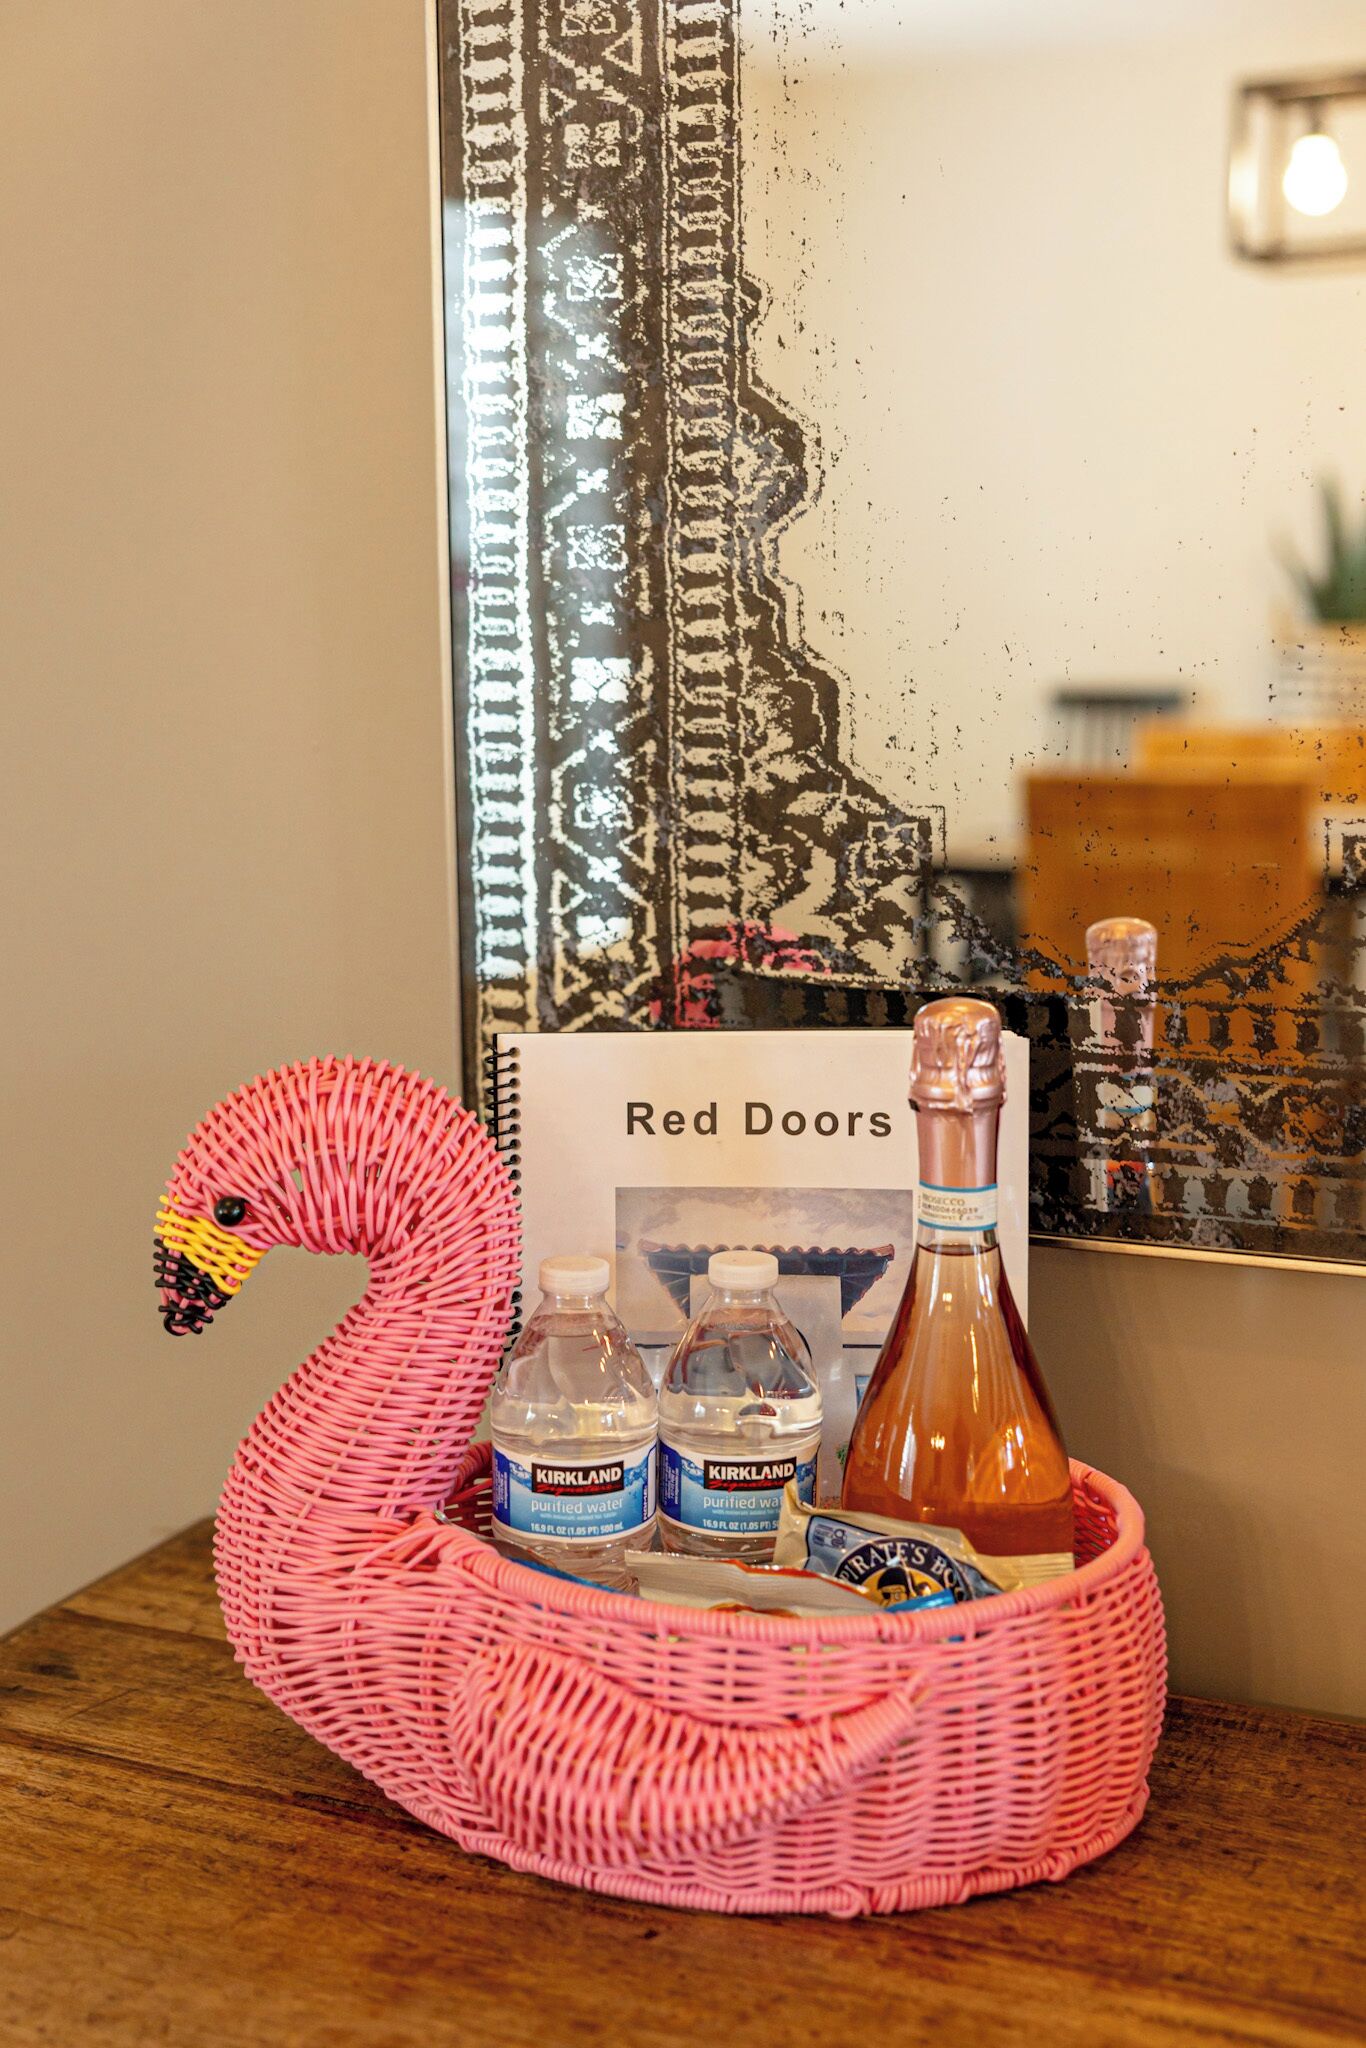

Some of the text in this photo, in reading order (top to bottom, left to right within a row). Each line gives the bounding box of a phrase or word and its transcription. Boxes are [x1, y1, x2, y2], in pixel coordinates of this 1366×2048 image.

[627, 1102, 892, 1138] Red Doors
[536, 1467, 622, 1485] KIRKLAND
[708, 1463, 795, 1480] KIRKLAND
[531, 1498, 623, 1514] purified water
[703, 1496, 756, 1510] purified
[530, 1522, 546, 1533] 16.9
[703, 1519, 718, 1529] 16.9
[839, 1541, 928, 1582] PIRATE'S
